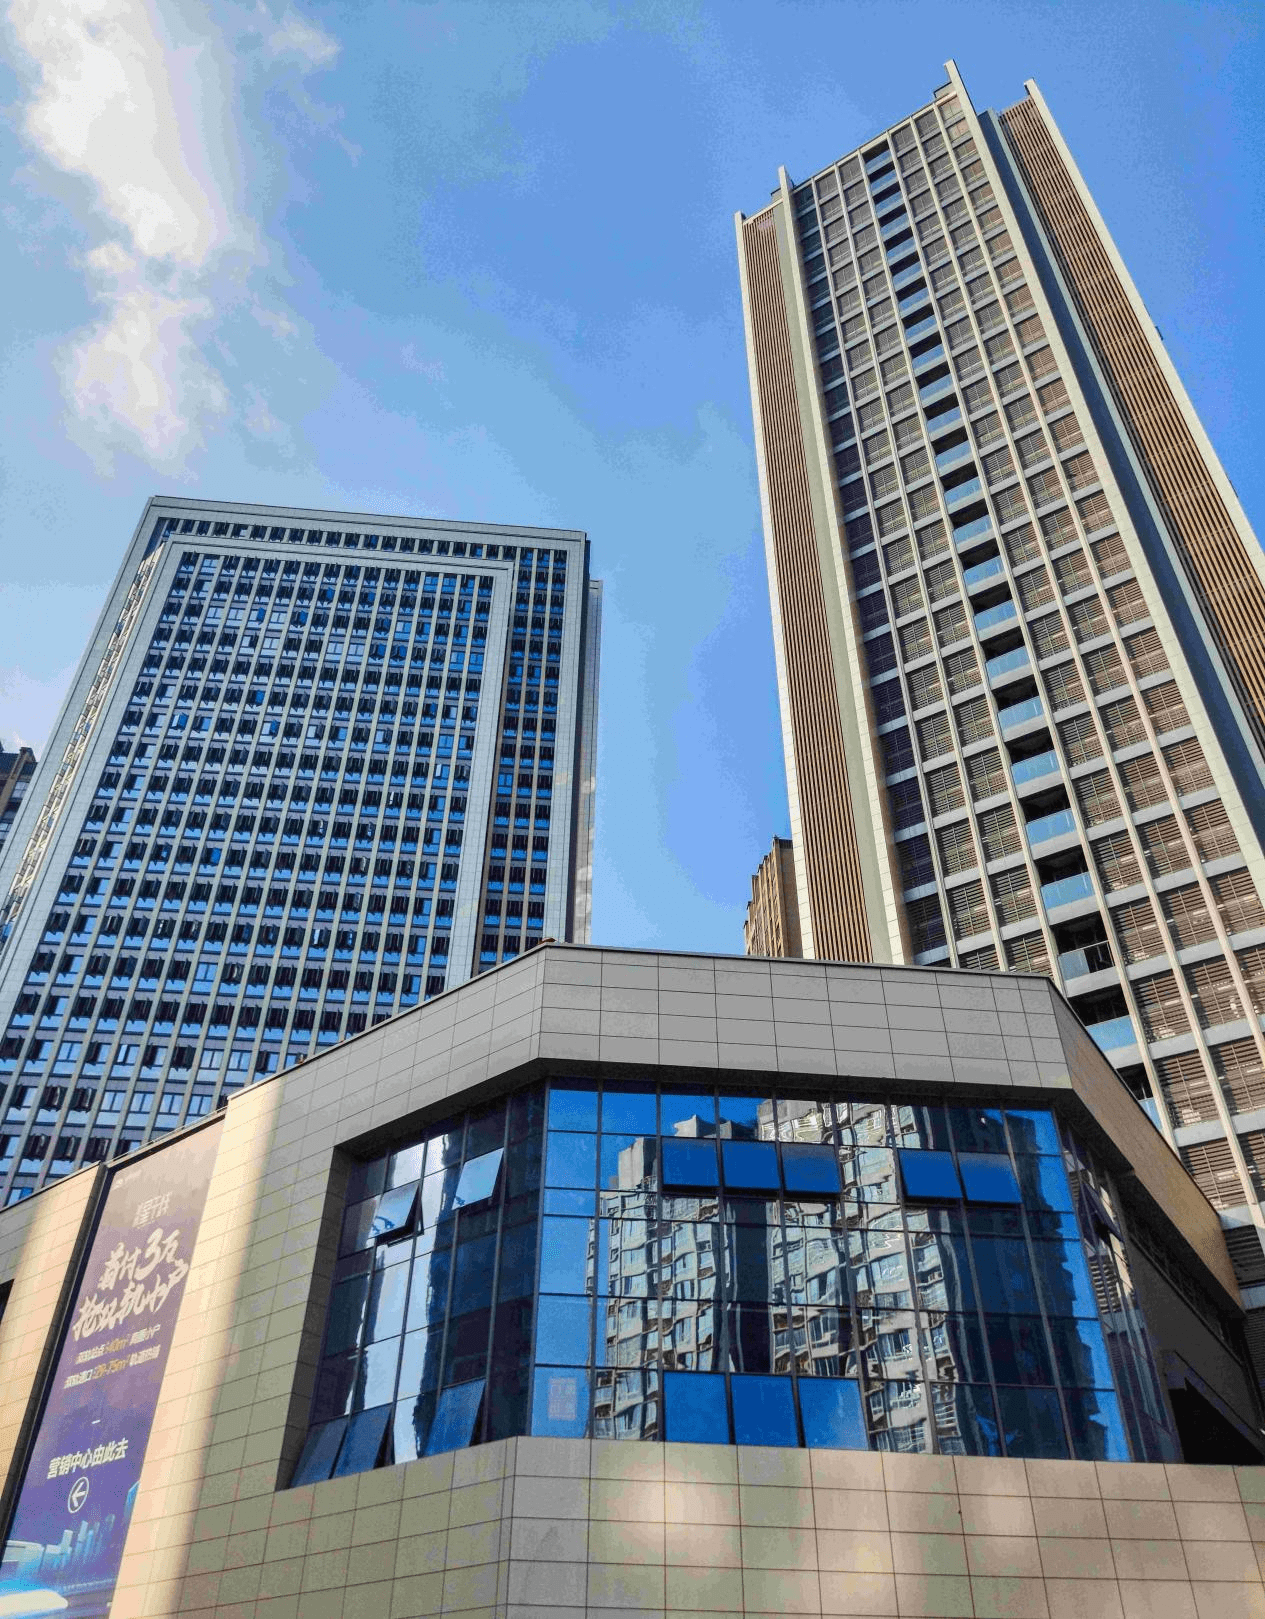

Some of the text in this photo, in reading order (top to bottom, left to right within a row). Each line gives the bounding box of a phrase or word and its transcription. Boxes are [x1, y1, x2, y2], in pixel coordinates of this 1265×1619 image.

[97, 1227, 180, 1290] 首付3万
[46, 1437, 129, 1480] 营销中心由此去
